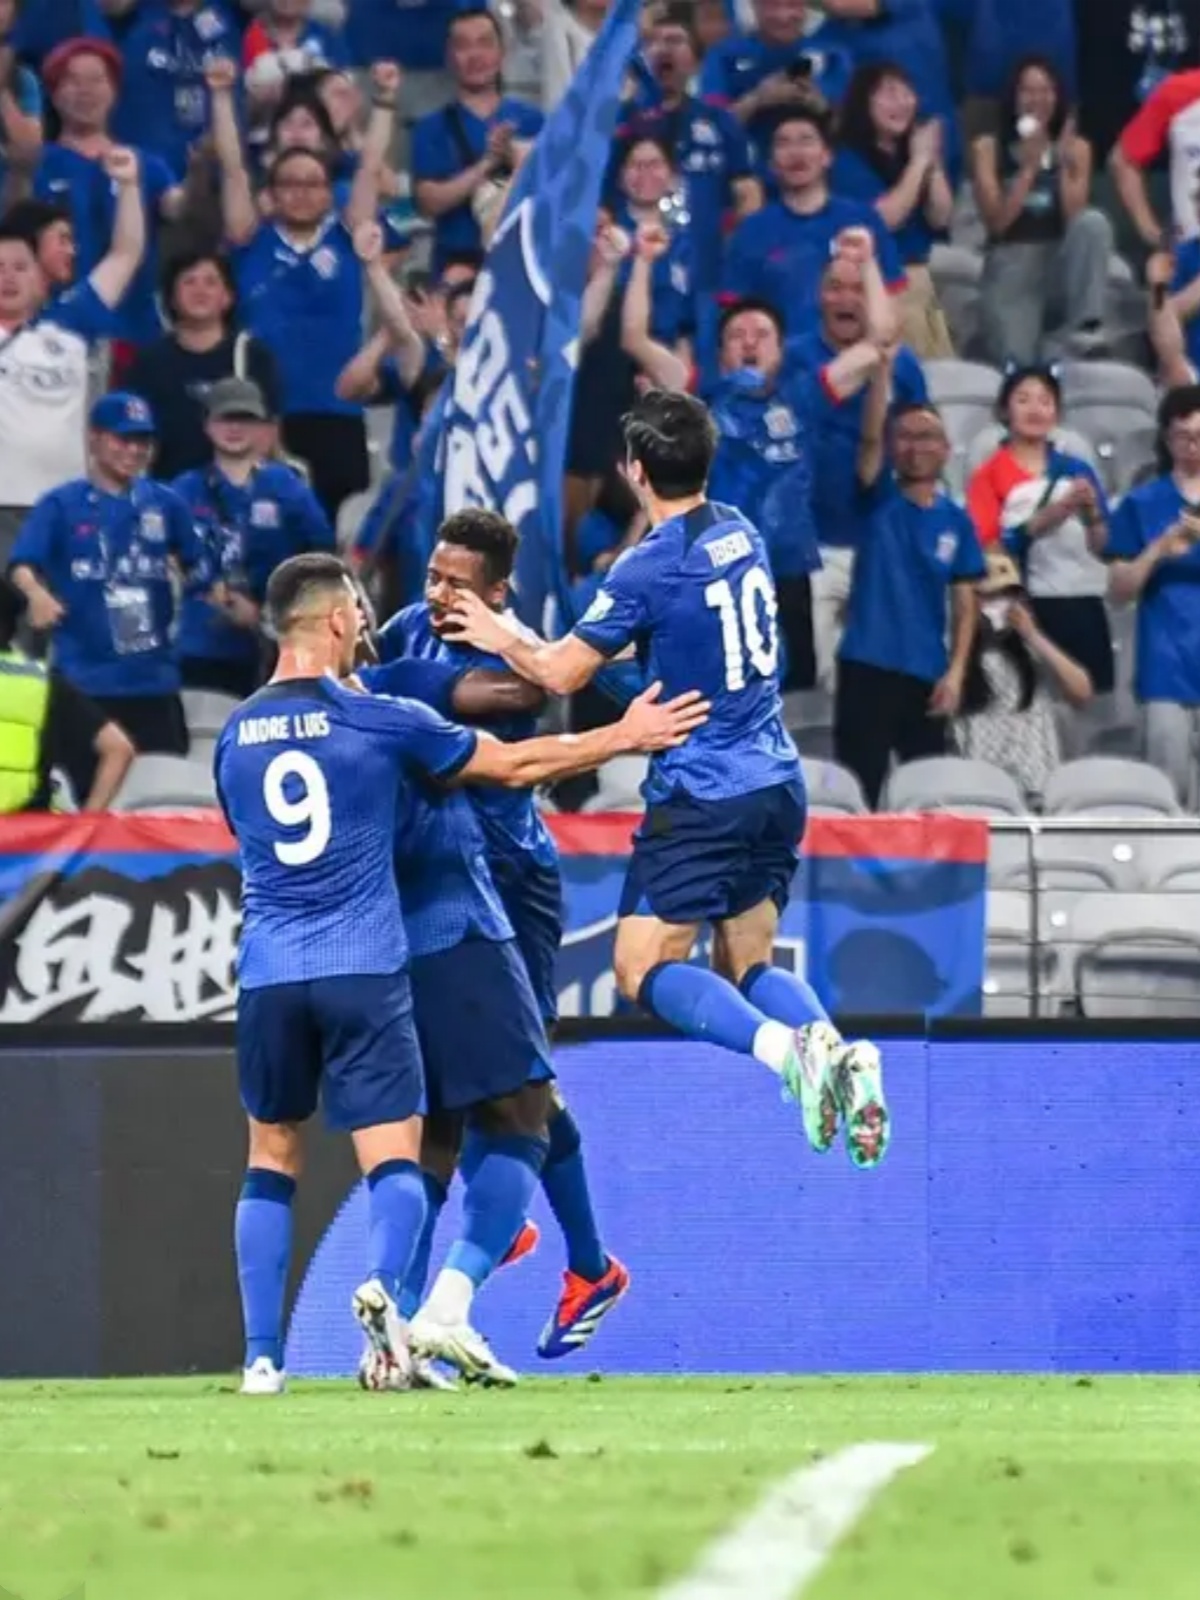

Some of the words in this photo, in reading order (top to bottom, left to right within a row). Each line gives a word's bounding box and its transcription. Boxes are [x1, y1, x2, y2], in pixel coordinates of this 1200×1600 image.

[705, 567, 778, 691] 10
[238, 715, 290, 746] ANDRE
[293, 711, 330, 739] LUIS
[263, 750, 331, 866] 9
